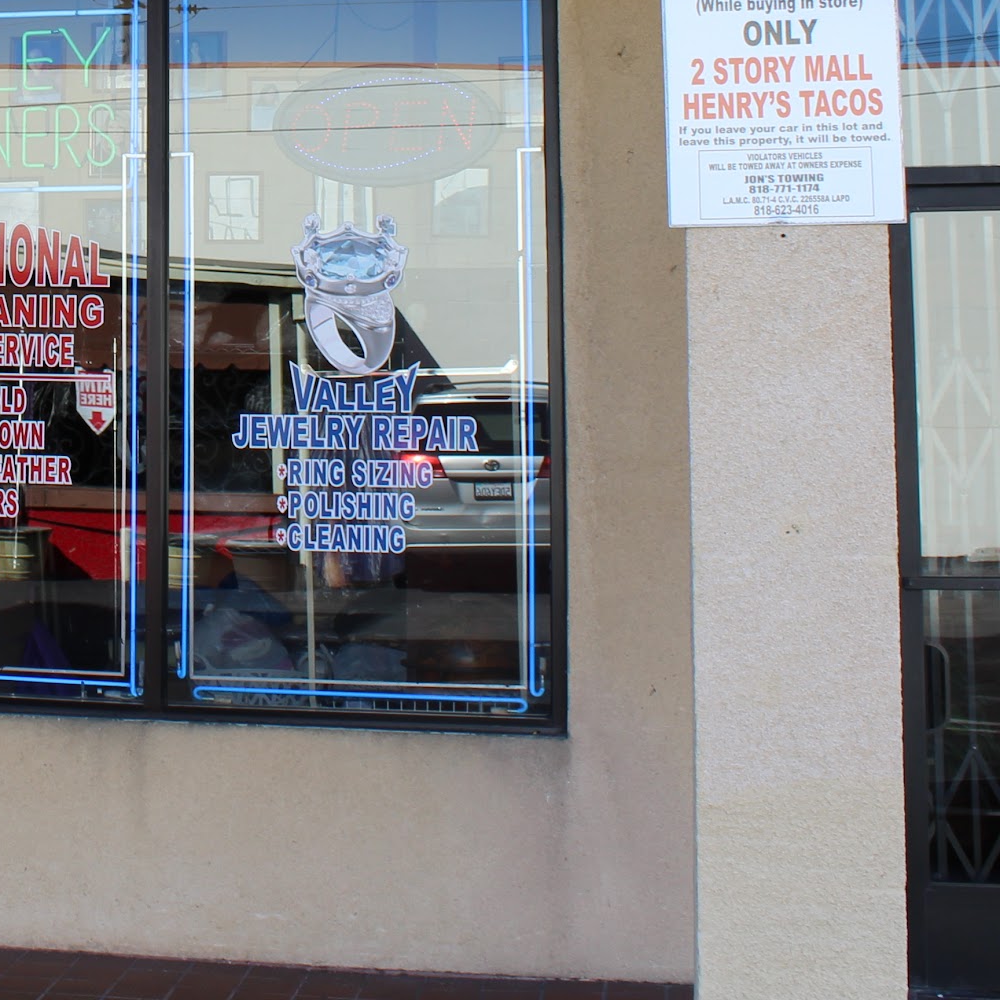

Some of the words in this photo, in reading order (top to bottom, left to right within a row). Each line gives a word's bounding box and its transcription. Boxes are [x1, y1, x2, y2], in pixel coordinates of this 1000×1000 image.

[742, 18, 818, 47] ONLY
[690, 57, 705, 86] 2
[713, 55, 796, 85] STORY
[804, 54, 873, 83] MALL
[683, 90, 792, 120] HENRY'S
[799, 88, 884, 118] TACOS
[292, 97, 476, 152] OPEN
[679, 125, 688, 135] If
[691, 127, 712, 137] you
[715, 125, 746, 134] leave
[750, 126, 776, 136] your
[779, 125, 798, 133] car
[802, 123, 813, 132] in
[816, 123, 839, 132] this
[842, 122, 858, 131] lot
[861, 121, 883, 131] and
[679, 137, 710, 146] leave
[713, 136, 736, 146] this
[739, 135, 793, 147] property,
[795, 135, 804, 144] it
[808, 134, 829, 143] will
[832, 134, 847, 143] be
[850, 132, 891, 142] towed.
[708, 163, 726, 171] WILL
[727, 163, 737, 171] BE
[738, 162, 763, 171] TOWED
[764, 161, 785, 170] AWAY
[787, 161, 797, 170] AT
[797, 160, 829, 169] OWNERS
[830, 160, 863, 169] EXPENSE
[747, 152, 787, 161] VIOLATORS
[788, 151, 823, 160] VEHICLES
[744, 174, 775, 184] JON'S
[778, 173, 825, 183] TOWING
[748, 183, 820, 194] 818-771-1174
[753, 204, 820, 216] 818-623-4016
[288, 360, 421, 415] VALLEY
[231, 413, 365, 450] JEWELRY
[371, 415, 479, 452] REPAIR
[286, 458, 346, 488] RING
[350, 458, 434, 489] SIZING
[286, 491, 416, 521] POLISHING
[286, 523, 406, 553] CLEANING
